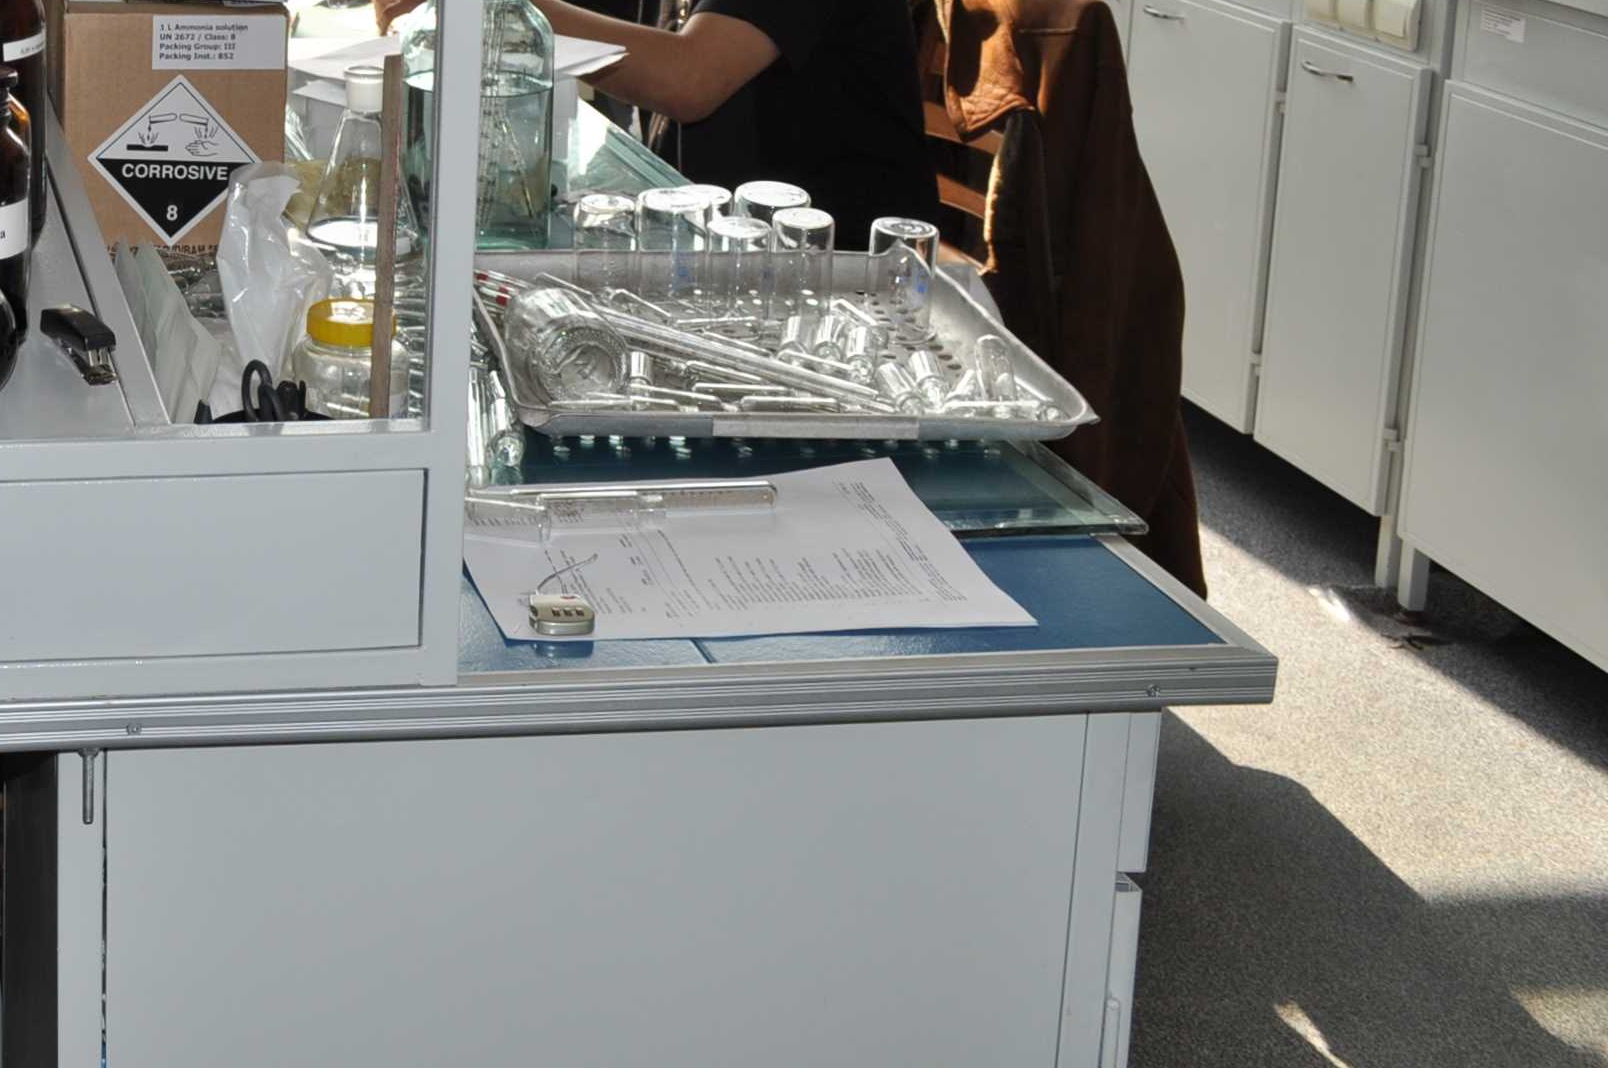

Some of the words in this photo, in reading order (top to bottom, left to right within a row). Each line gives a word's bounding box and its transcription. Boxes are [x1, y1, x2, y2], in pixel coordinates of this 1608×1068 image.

[159, 43, 192, 51] Packing
[193, 43, 221, 51] Group:
[159, 53, 192, 61] Packing
[121, 163, 229, 181] CORROSIVE
[166, 204, 178, 221] 8
